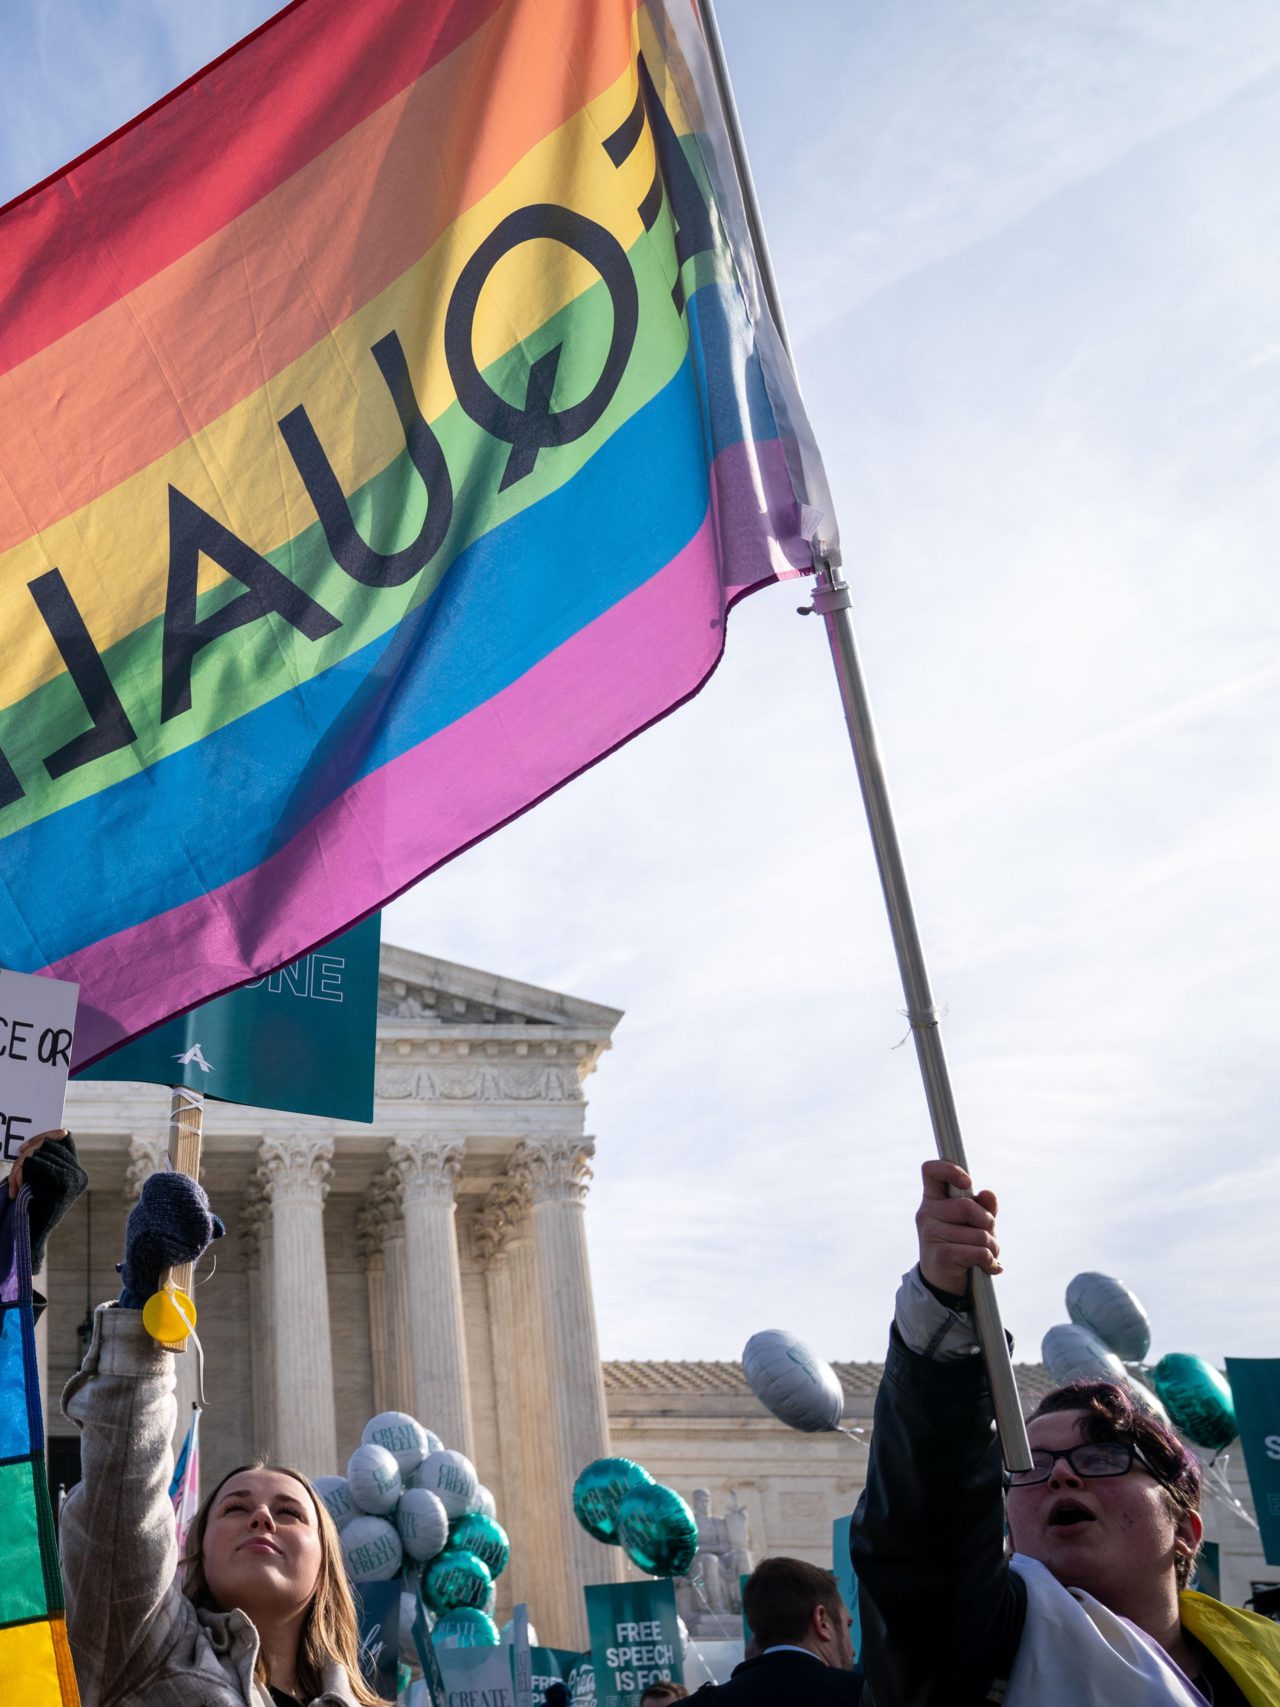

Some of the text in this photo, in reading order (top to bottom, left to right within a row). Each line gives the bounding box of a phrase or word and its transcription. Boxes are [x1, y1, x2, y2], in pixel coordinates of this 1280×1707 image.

[37, 1027, 73, 1067] OR
[616, 1620, 663, 1643] FREE
[605, 1643, 675, 1668] SPEECH
[615, 1670, 636, 1692] IS
